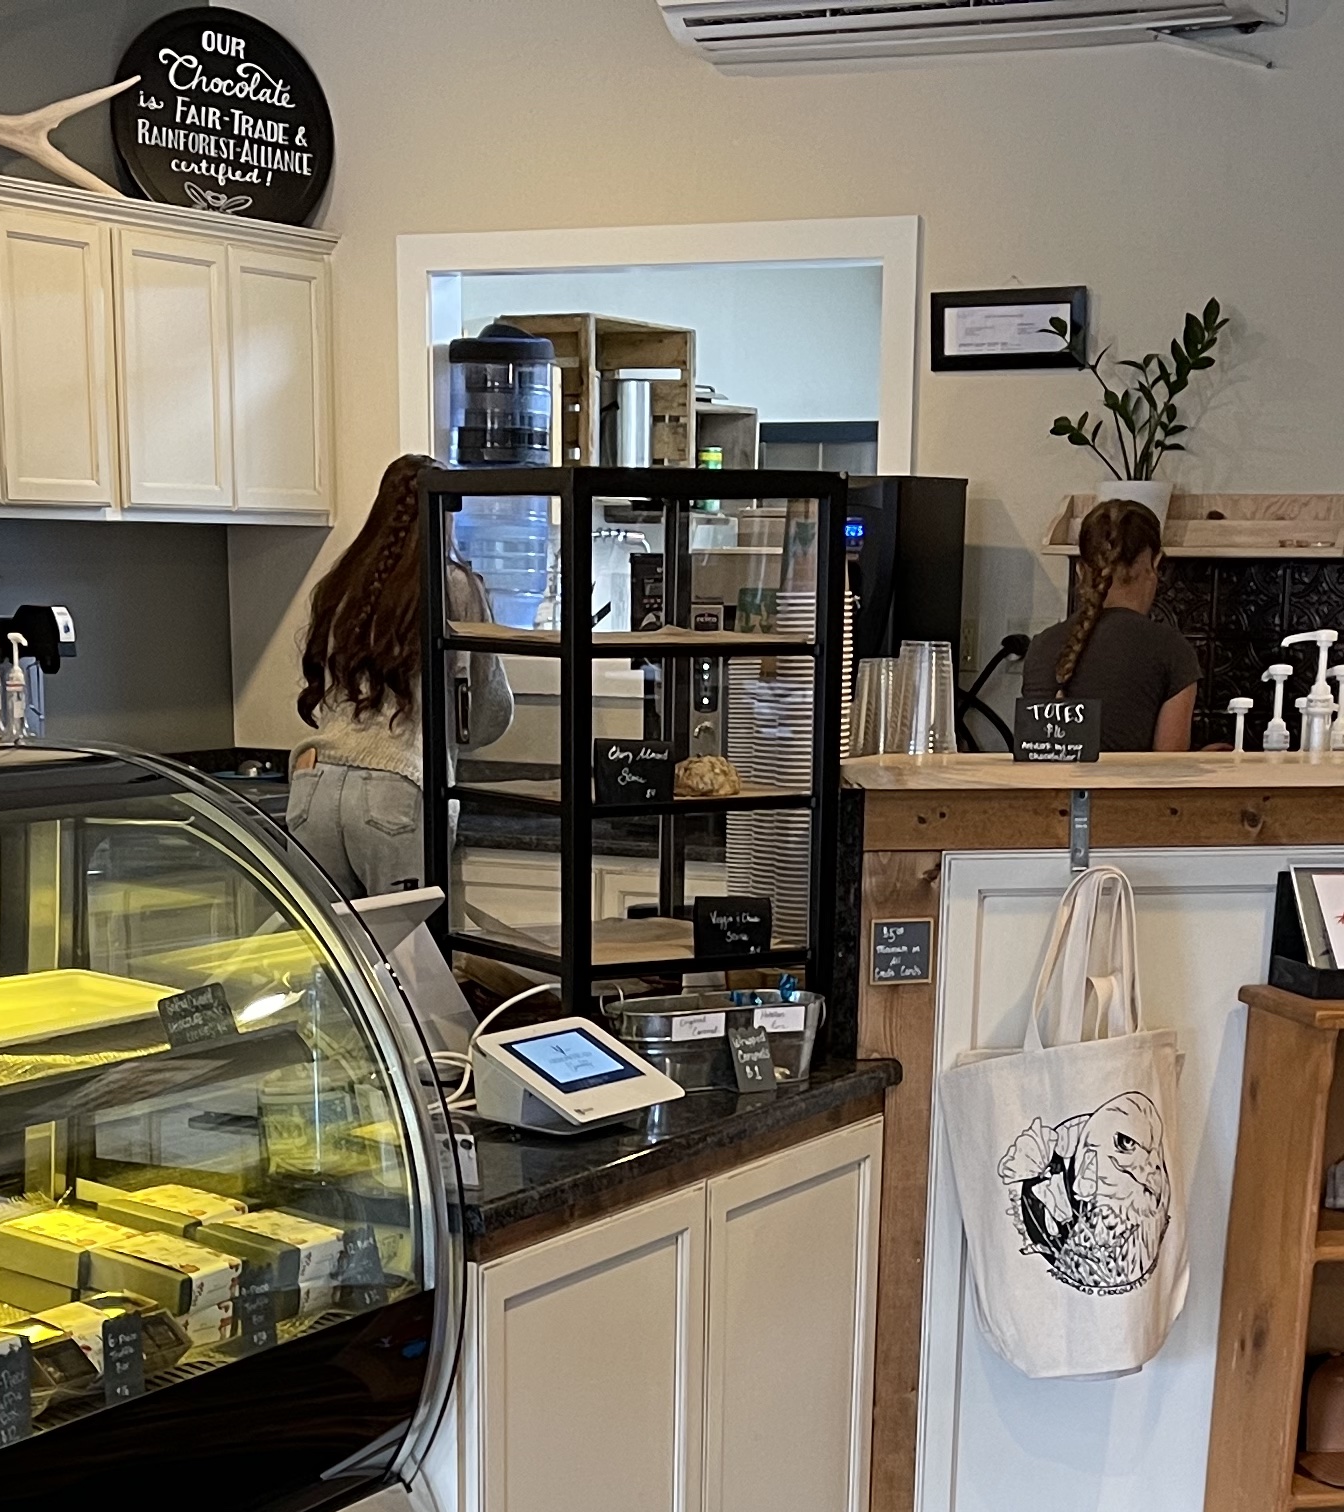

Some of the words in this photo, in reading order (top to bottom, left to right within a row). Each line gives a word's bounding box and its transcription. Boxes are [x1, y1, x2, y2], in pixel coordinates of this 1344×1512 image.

[202, 30, 246, 59] OUR
[159, 48, 296, 109] Chocolate
[139, 91, 164, 110] is
[294, 126, 309, 148] &
[1026, 702, 1085, 724] TOTES
